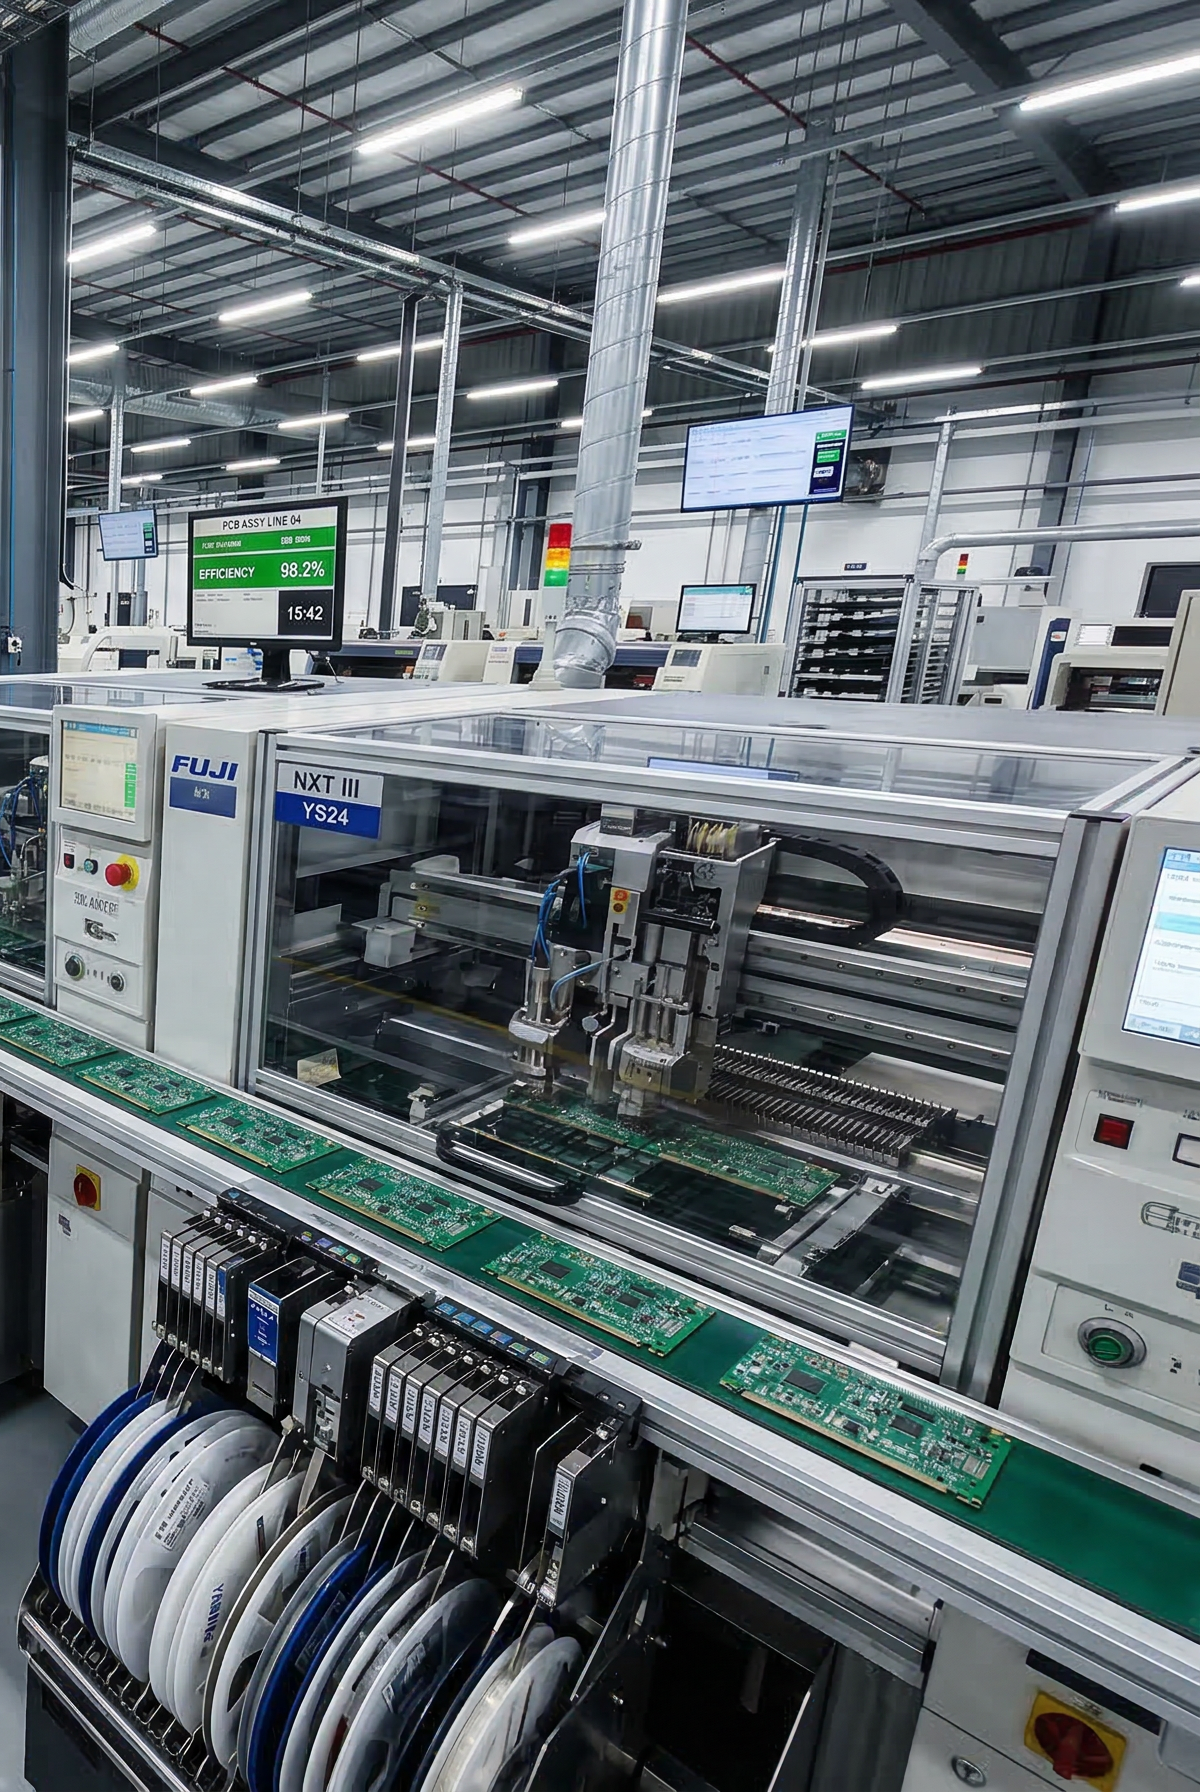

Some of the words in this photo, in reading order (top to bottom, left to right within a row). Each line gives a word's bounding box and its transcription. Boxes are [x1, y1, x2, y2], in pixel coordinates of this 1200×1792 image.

[222, 519, 240, 531] PCB
[241, 518, 266, 529] ASSY
[267, 515, 288, 527] LINE
[290, 514, 302, 525] 04
[199, 566, 255, 580] EFFICIENCY
[280, 560, 325, 578] 98.2%
[287, 605, 324, 621] 15:42
[171, 755, 239, 781] FUJI
[294, 770, 335, 795] NXT
[341, 777, 360, 799] III
[302, 801, 349, 826] YS24
